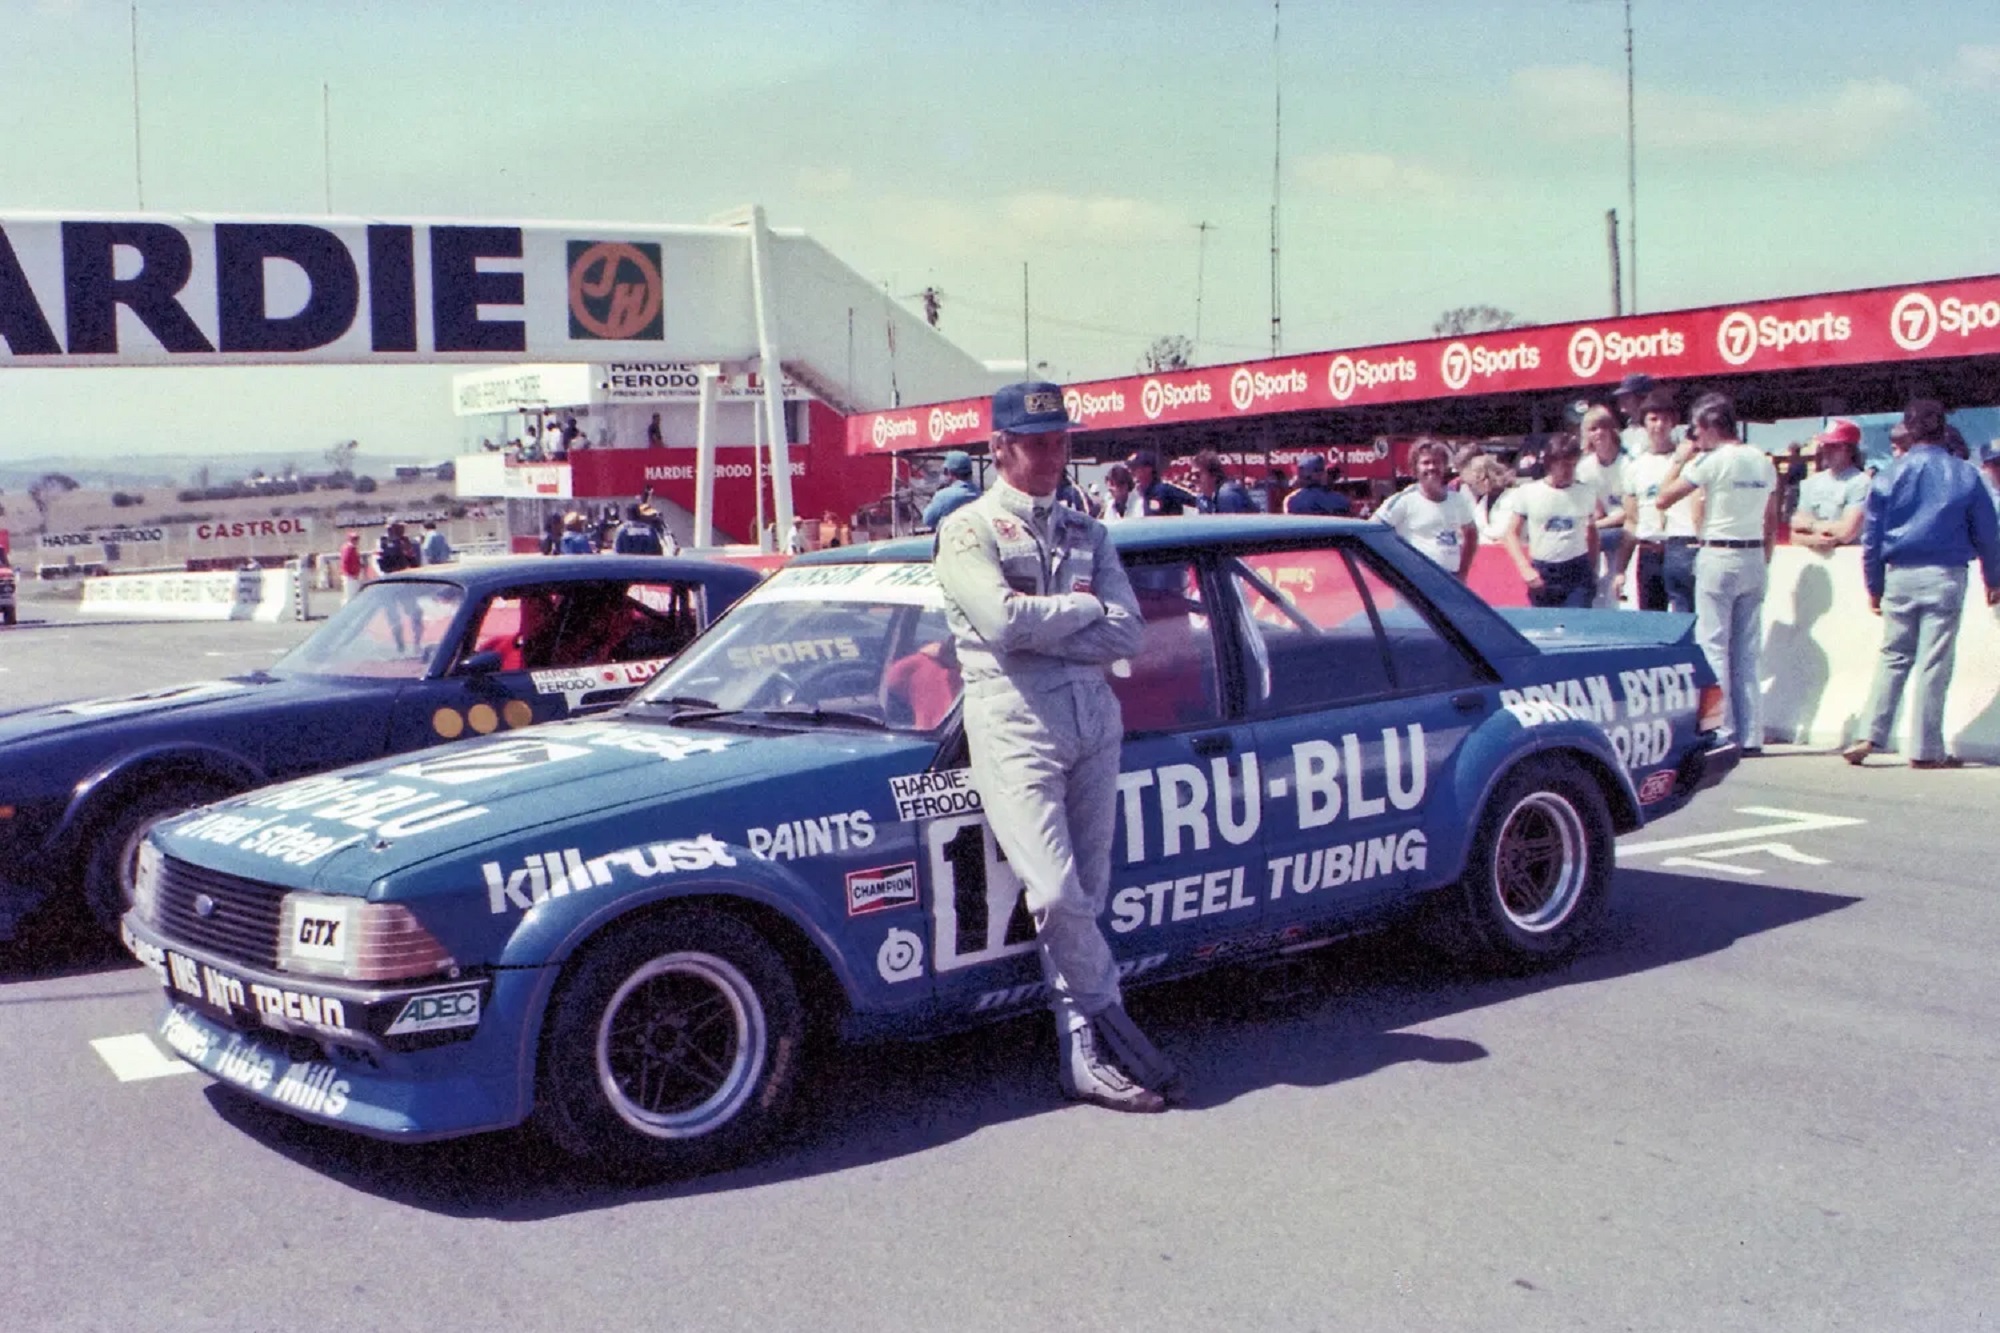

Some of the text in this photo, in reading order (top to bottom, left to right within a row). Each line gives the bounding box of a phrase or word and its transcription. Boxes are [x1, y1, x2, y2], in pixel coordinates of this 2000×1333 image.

[1604, 327, 1685, 365] Sports
[1758, 313, 1851, 351] Sports
[1356, 355, 1416, 390] Sports
[1473, 342, 1540, 377] Sports
[611, 374, 699, 388] FERODO
[1163, 379, 1211, 409] Sports
[1254, 367, 1307, 399] Sports
[1083, 391, 1124, 415] Sports
[887, 417, 917, 438] Sports
[943, 409, 979, 434] Sports
[645, 465, 693, 480] HARDIE
[42, 533, 92, 547] HARDIE
[197, 519, 307, 540] CASTROL
[727, 637, 860, 668] SPORTS
[539, 677, 596, 693] FERODO
[1499, 663, 1700, 729] BRYAN BYRT
[1606, 718, 1673, 768] ORD
[900, 789, 981, 819] FERODO
[1116, 723, 1428, 864] TRU-BLU
[482, 810, 876, 914] killrust PAINTS
[853, 876, 913, 900] CHAMPION
[1111, 828, 1428, 933] STEEL TUBING
[299, 917, 341, 947] GTX
[252, 984, 345, 1029] TREND
[396, 991, 476, 1024] ADEC
